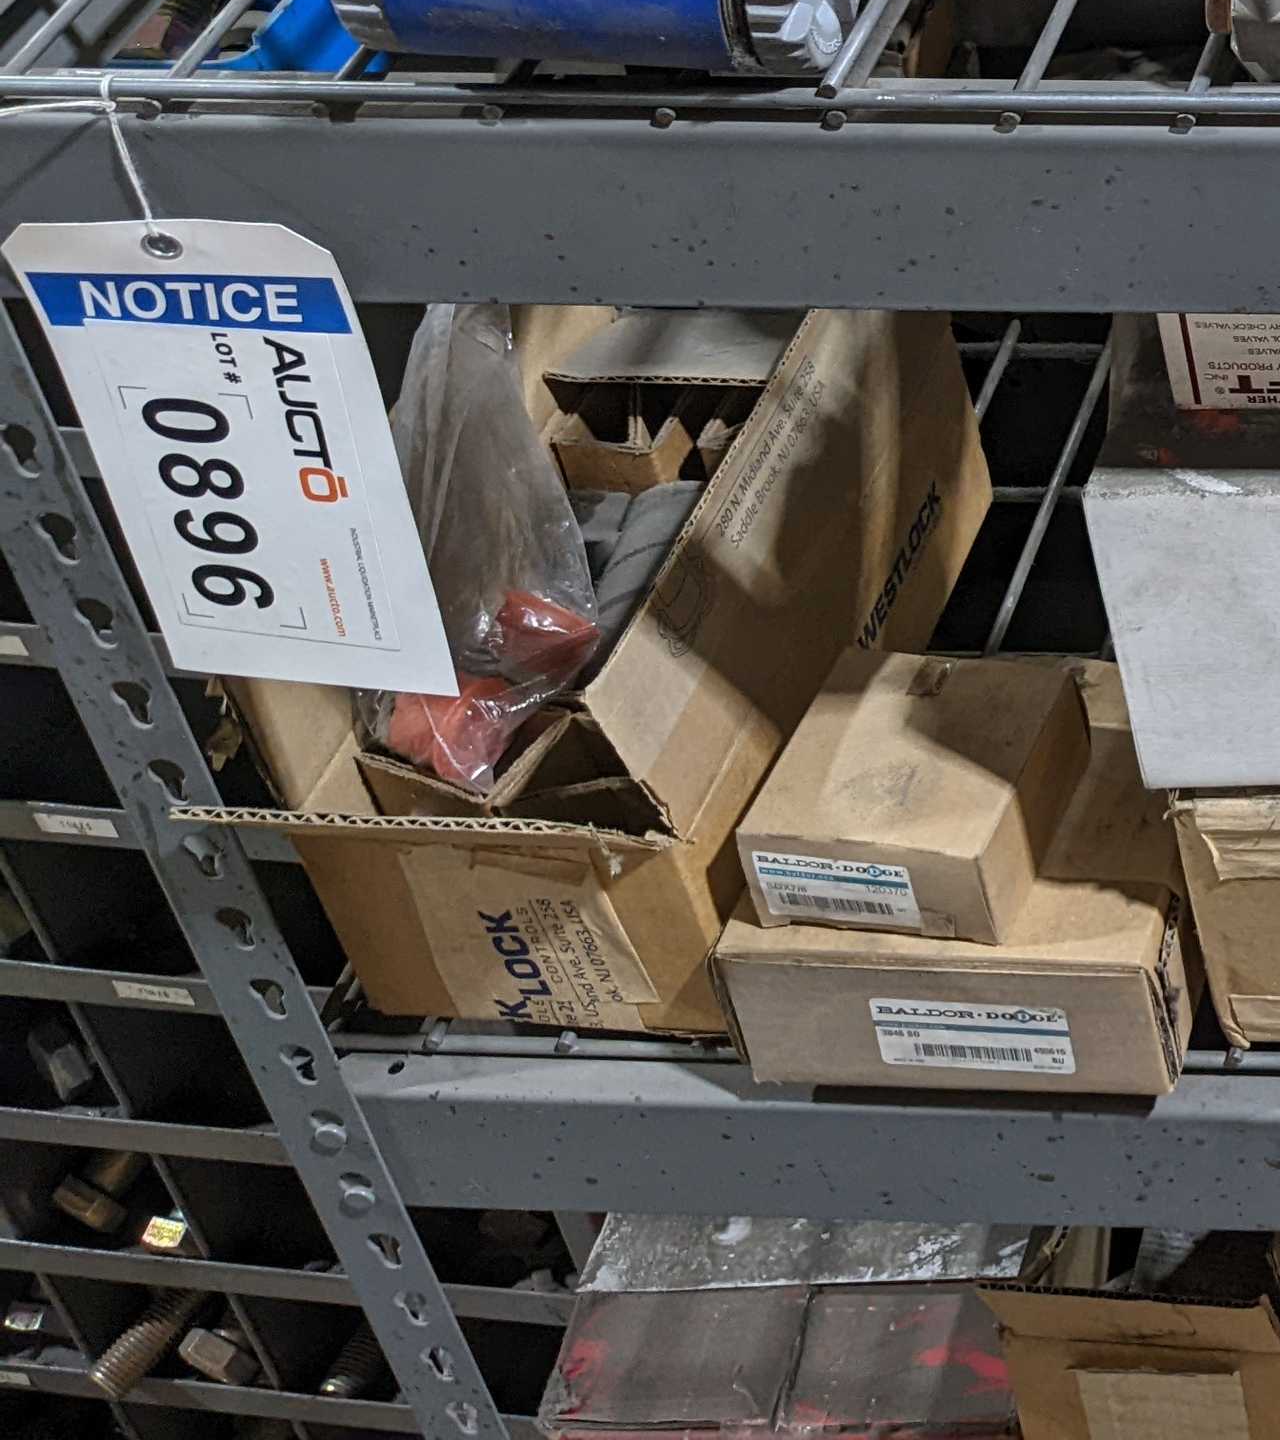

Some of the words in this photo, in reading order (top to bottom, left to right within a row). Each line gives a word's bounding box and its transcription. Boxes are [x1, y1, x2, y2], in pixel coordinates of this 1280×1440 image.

[78, 280, 303, 323] NOTICE
[1232, 321, 1266, 330] CHECK
[210, 332, 237, 370] LOT
[224, 371, 242, 385] #
[1232, 334, 1269, 342] VALVES
[1207, 361, 1273, 371] PRODUCTS
[262, 336, 350, 505] AUCTO
[716, 509, 735, 538] 280
[740, 440, 773, 496] Midland
[783, 386, 806, 420] Suite
[730, 506, 761, 549] Saddle
[808, 380, 827, 409] USA
[141, 397, 275, 610] 0896
[857, 480, 942, 651] WESTLOCK
[320, 557, 346, 637] www.aucto.com
[756, 855, 834, 872] BALDOR
[843, 864, 904, 879] DODGE
[559, 899, 584, 924] USA
[477, 908, 553, 997] LOCK
[516, 906, 563, 985] CONTROLS
[551, 923, 576, 955] Suite
[876, 1006, 975, 1020] BALDOR
[986, 1011, 1058, 1024] DODGE
